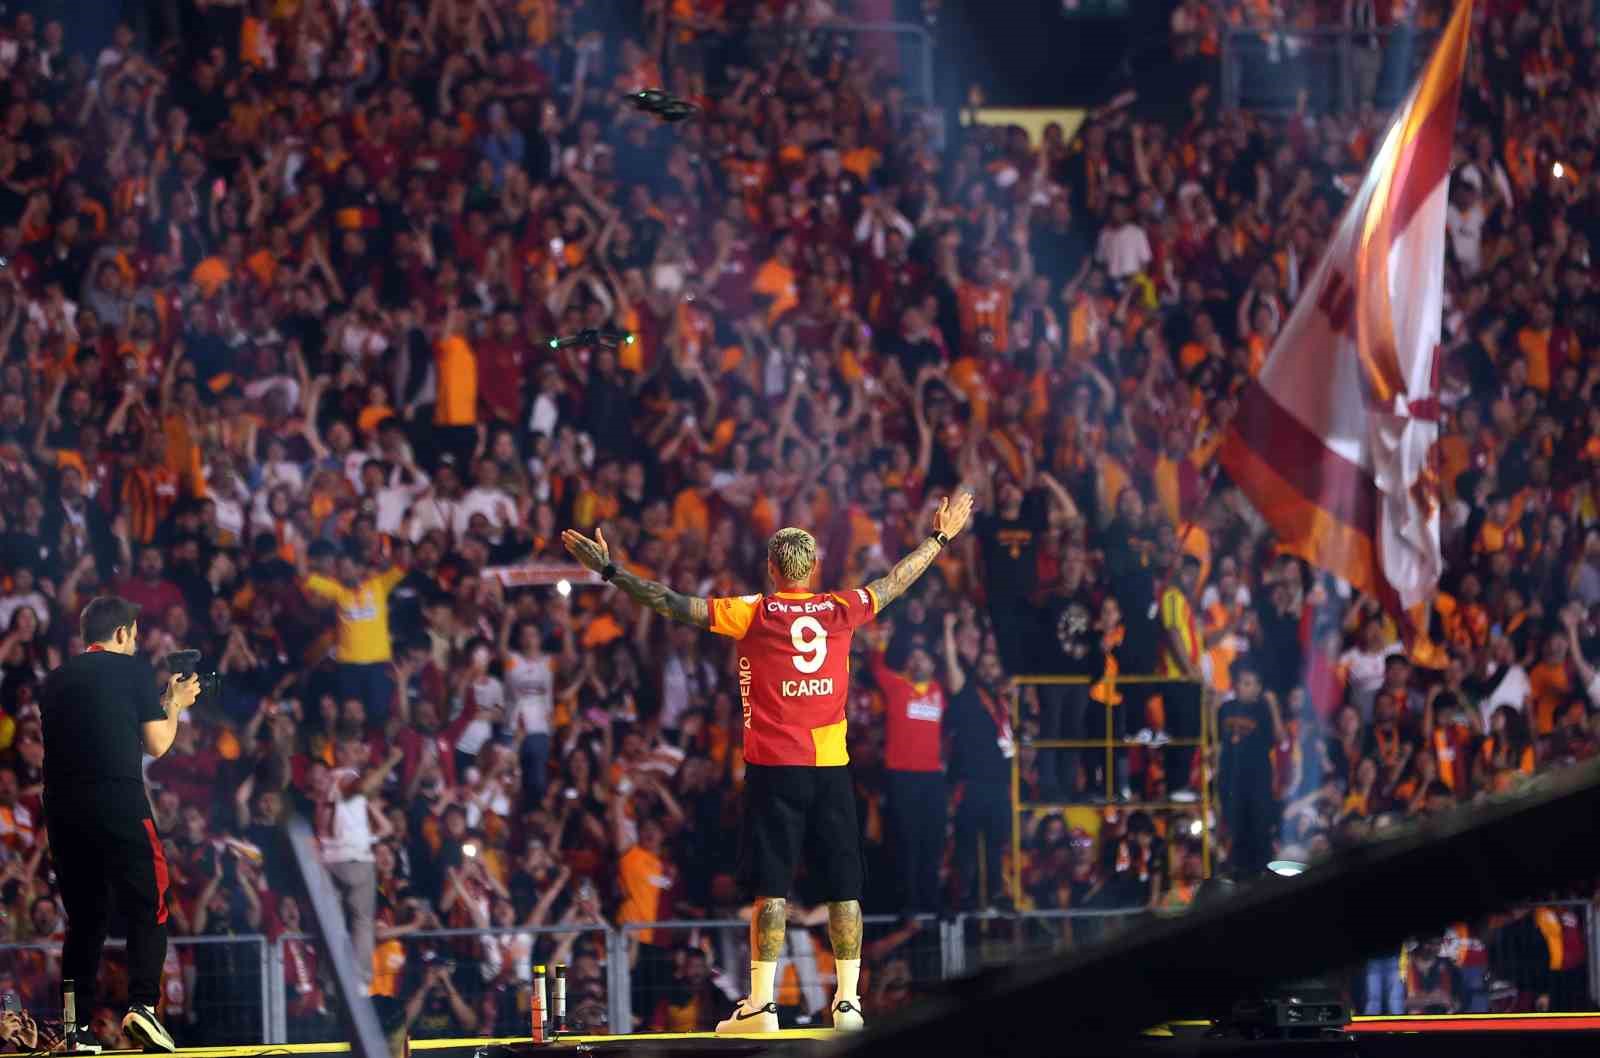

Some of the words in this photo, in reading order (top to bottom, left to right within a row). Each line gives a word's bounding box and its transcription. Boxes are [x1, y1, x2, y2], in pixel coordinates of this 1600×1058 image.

[790, 615, 828, 674] 9
[739, 656, 752, 729] ALFEMO
[782, 678, 833, 697] ICARDI
